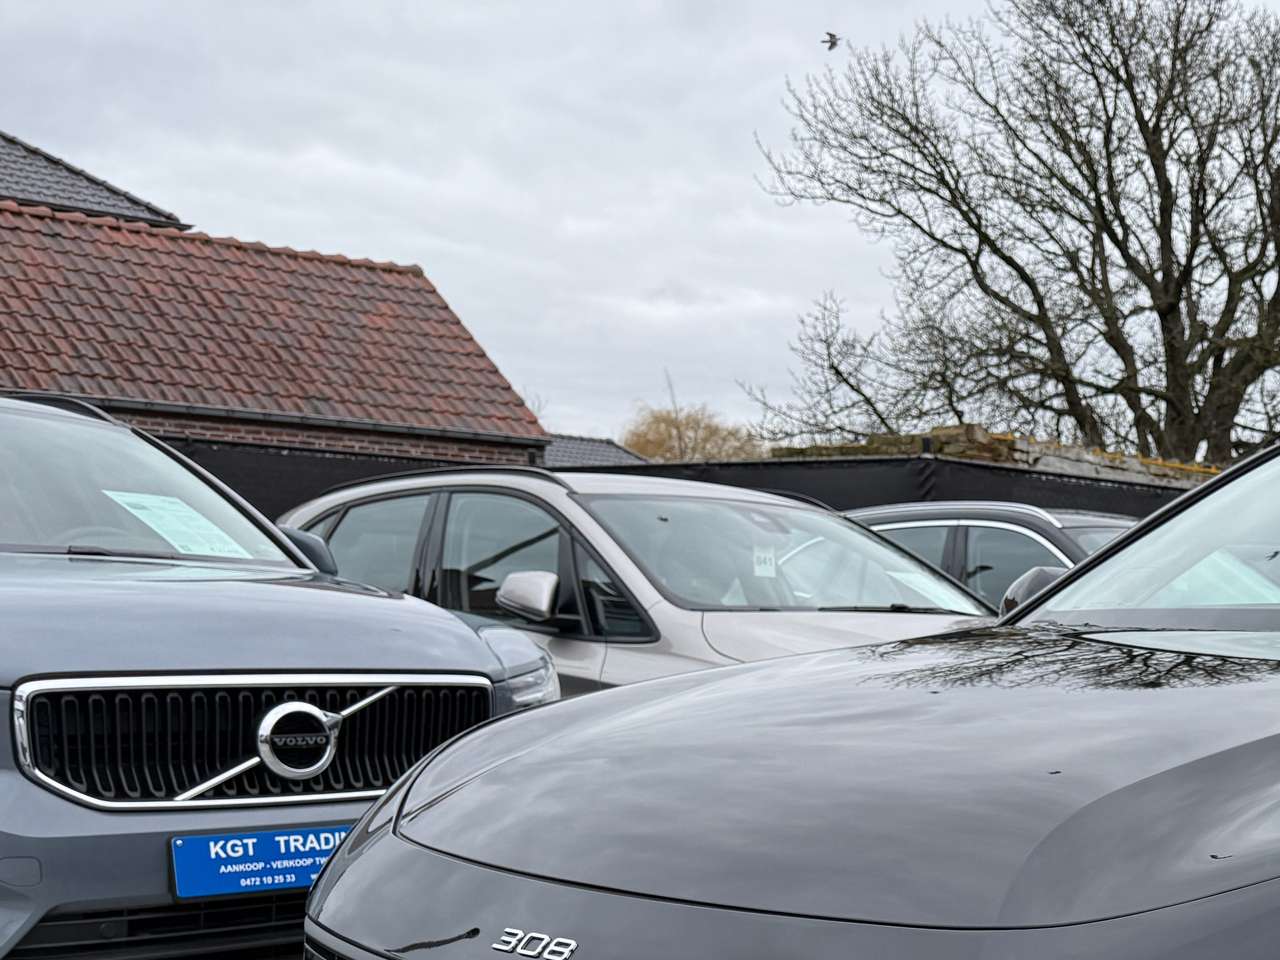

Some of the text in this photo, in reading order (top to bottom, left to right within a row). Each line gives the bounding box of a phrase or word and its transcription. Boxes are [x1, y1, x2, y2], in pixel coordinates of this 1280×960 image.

[273, 736, 326, 746] VOLVO
[209, 838, 257, 859] KGT
[220, 863, 265, 874] AANKOOP
[271, 859, 313, 870] VERKOOP
[240, 874, 296, 887] 0472 10 25 33
